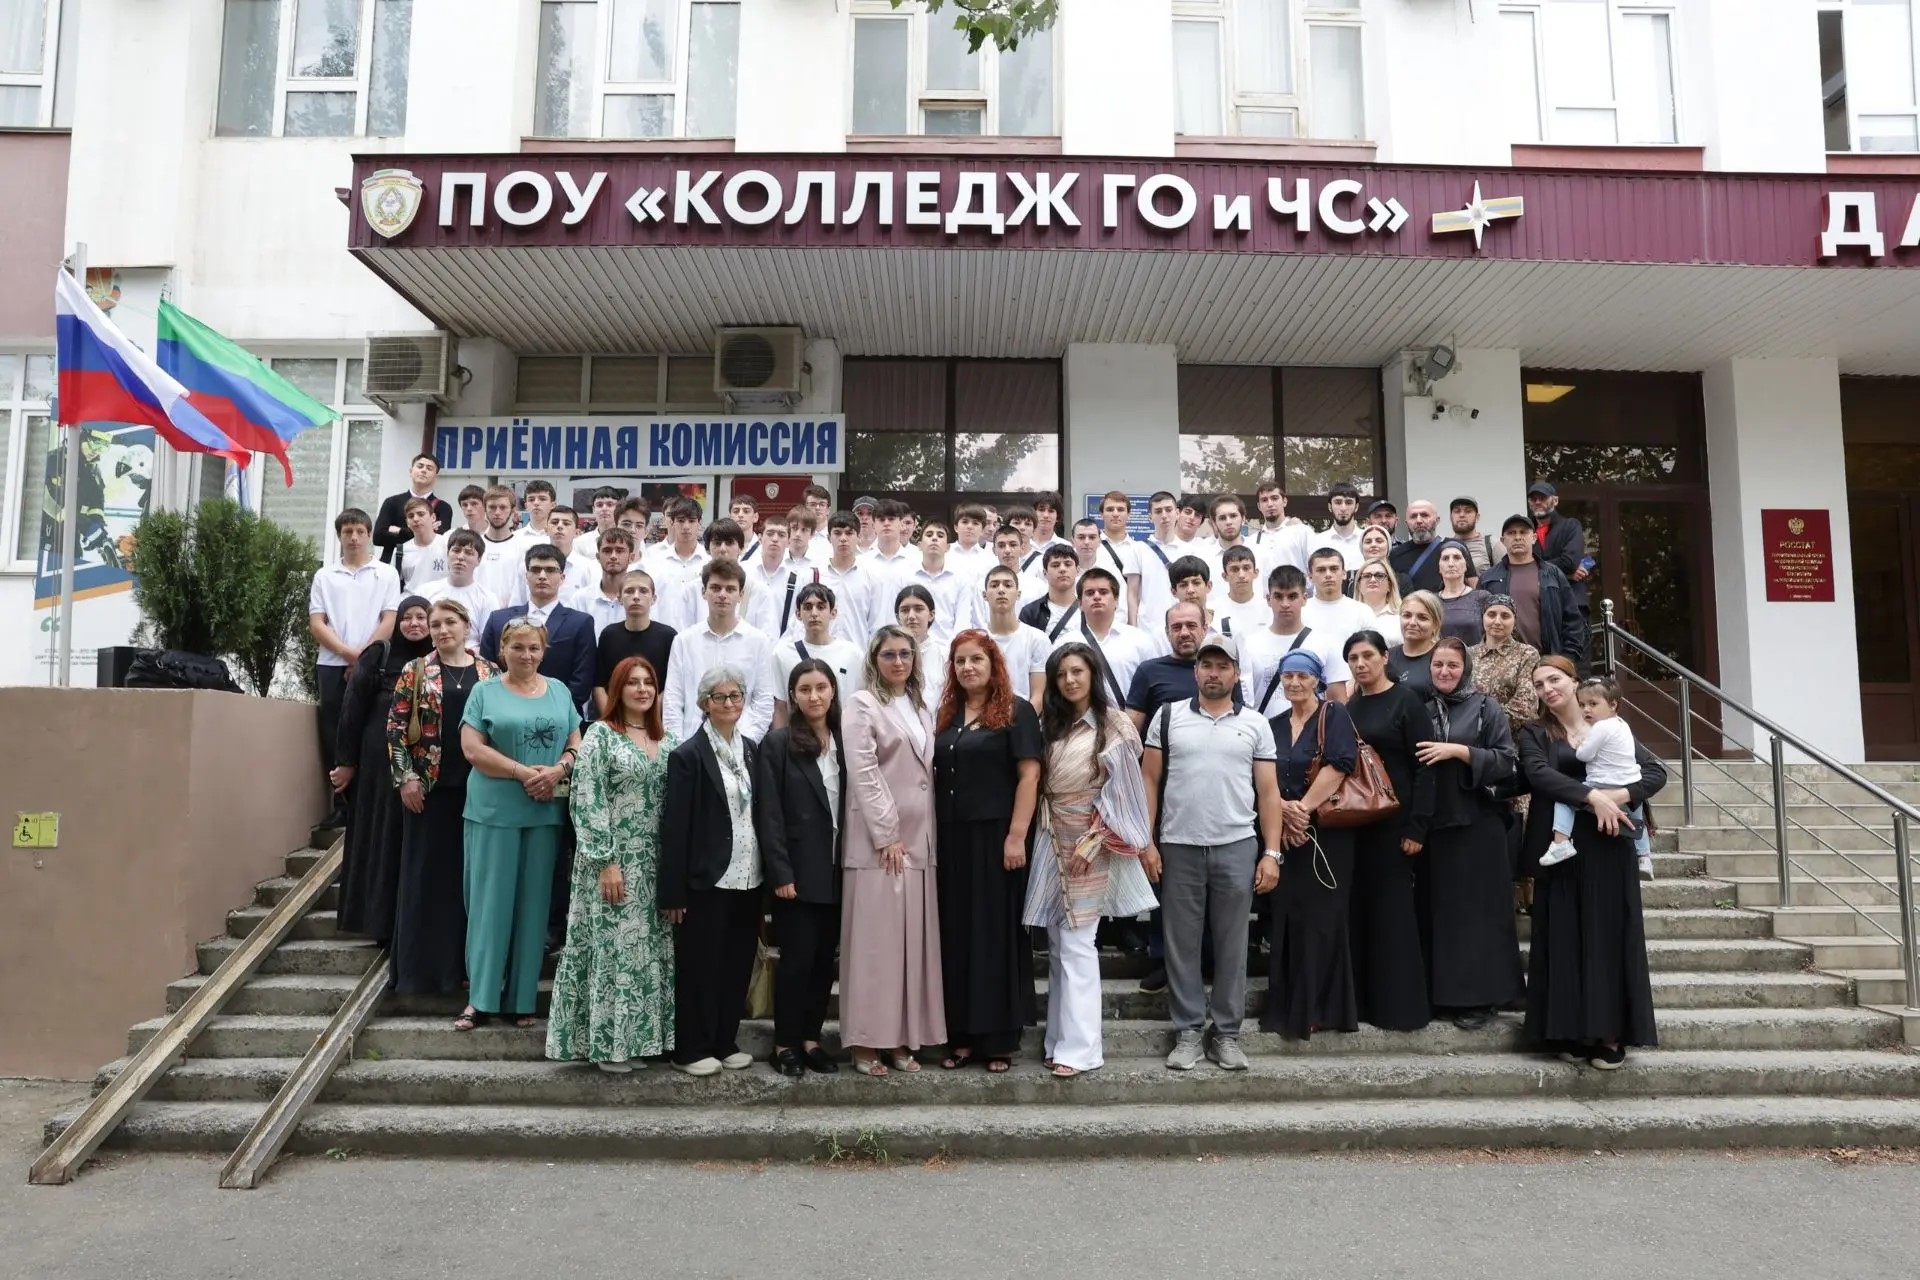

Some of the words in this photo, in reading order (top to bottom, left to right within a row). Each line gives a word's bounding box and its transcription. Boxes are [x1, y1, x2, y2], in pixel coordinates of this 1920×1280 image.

[438, 171, 607, 227] ПОУ
[625, 170, 1081, 234] «КОЛЛЕДЖ
[1103, 173, 1197, 229] ГО
[1214, 194, 1251, 230] и
[1268, 177, 1409, 234] ЧС»
[436, 419, 638, 470] ПРИЁМНАЯ
[649, 421, 837, 466] КОМИССИЯ
[1780, 541, 1816, 549] РОССТАТ
